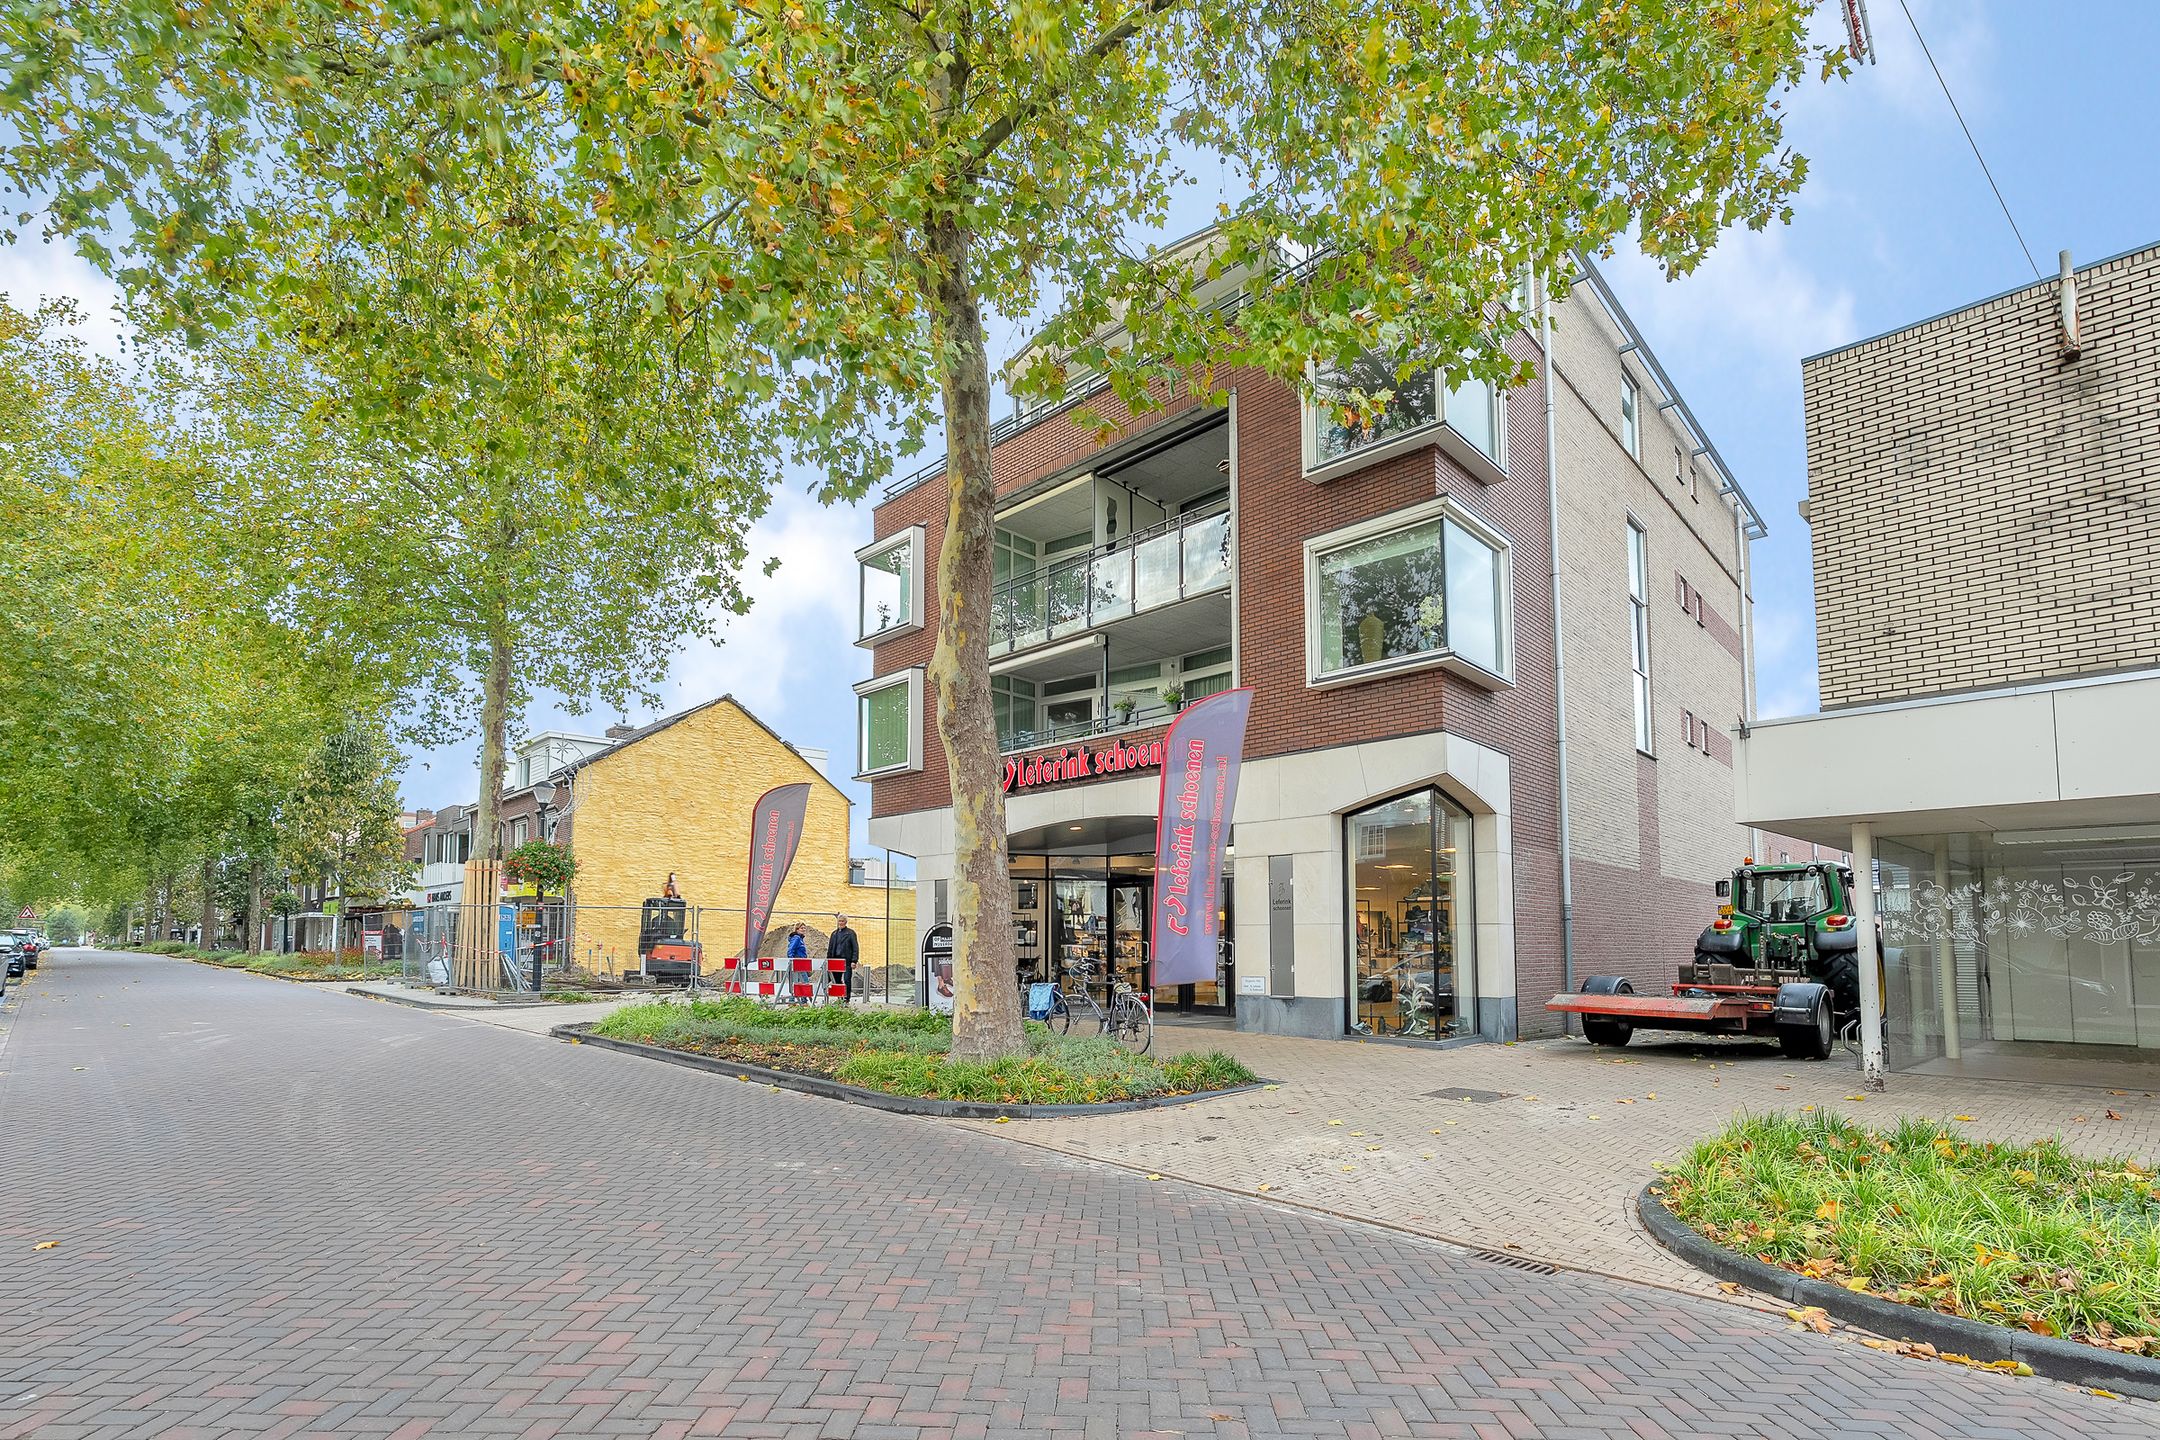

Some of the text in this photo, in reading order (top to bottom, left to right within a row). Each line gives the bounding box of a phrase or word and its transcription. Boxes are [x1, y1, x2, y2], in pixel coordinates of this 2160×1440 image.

[1018, 739, 1162, 787] Leferink schoen
[762, 809, 780, 860] schoenen
[1168, 739, 1204, 895] Leferink schoenen
